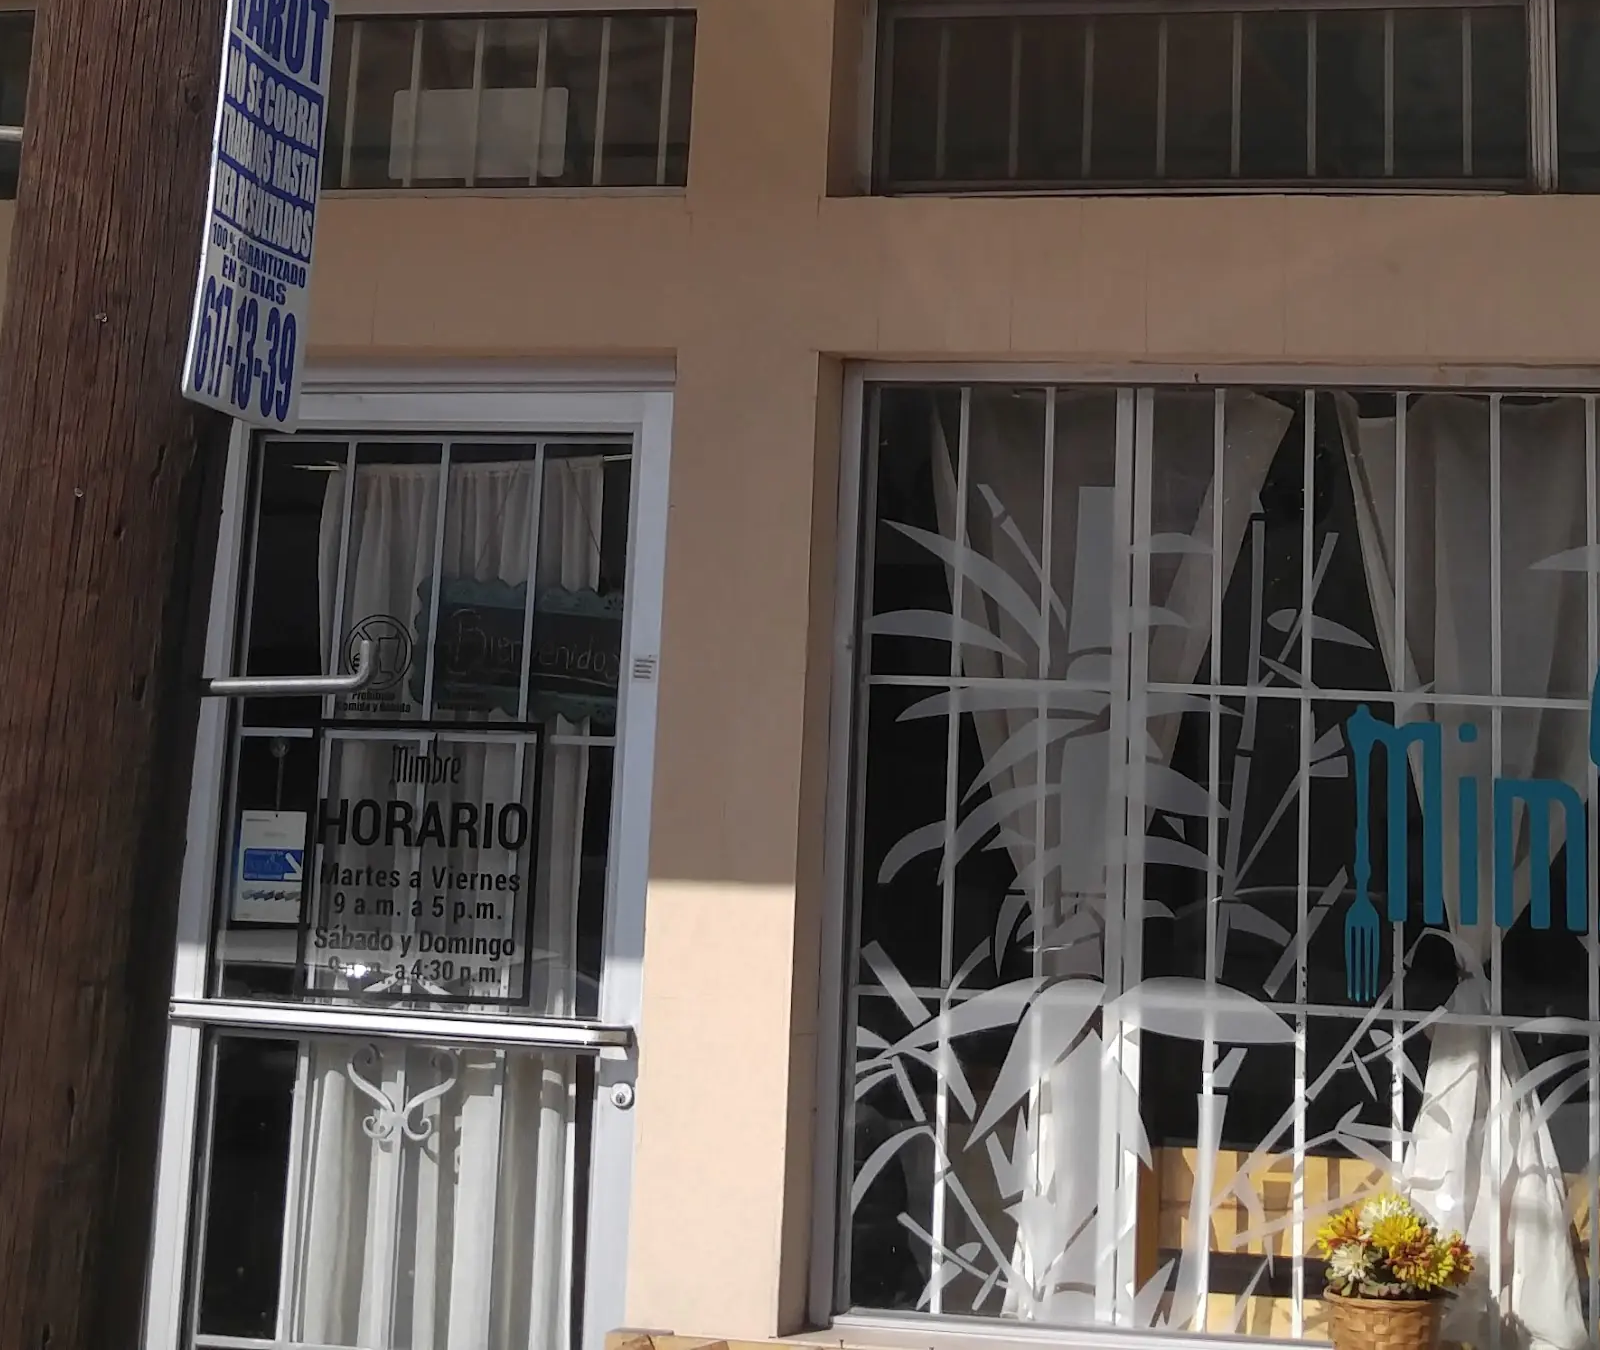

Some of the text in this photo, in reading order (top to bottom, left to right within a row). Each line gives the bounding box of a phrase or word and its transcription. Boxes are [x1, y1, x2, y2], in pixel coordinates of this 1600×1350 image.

[226, 45, 320, 150] NO SE COBRA
[220, 104, 317, 203] TRABAJOS HASTA
[214, 158, 313, 258] VER RESULTADOS
[212, 221, 229, 251] 100
[237, 237, 307, 289] GARANTIZADO
[221, 254, 287, 306] EN 3 DIAS
[194, 274, 297, 423] 617-13-39
[317, 797, 529, 850] HORARIO
[320, 862, 521, 892] Martes a Viernes
[333, 892, 346, 914] 9
[411, 899, 423, 917] a
[431, 895, 445, 918] 5
[453, 901, 502, 923] p.m.
[314, 923, 516, 962] Sábado y Domingo
[395, 963, 406, 980] a
[410, 959, 454, 981] 4:30
[459, 965, 502, 987] p.m.
